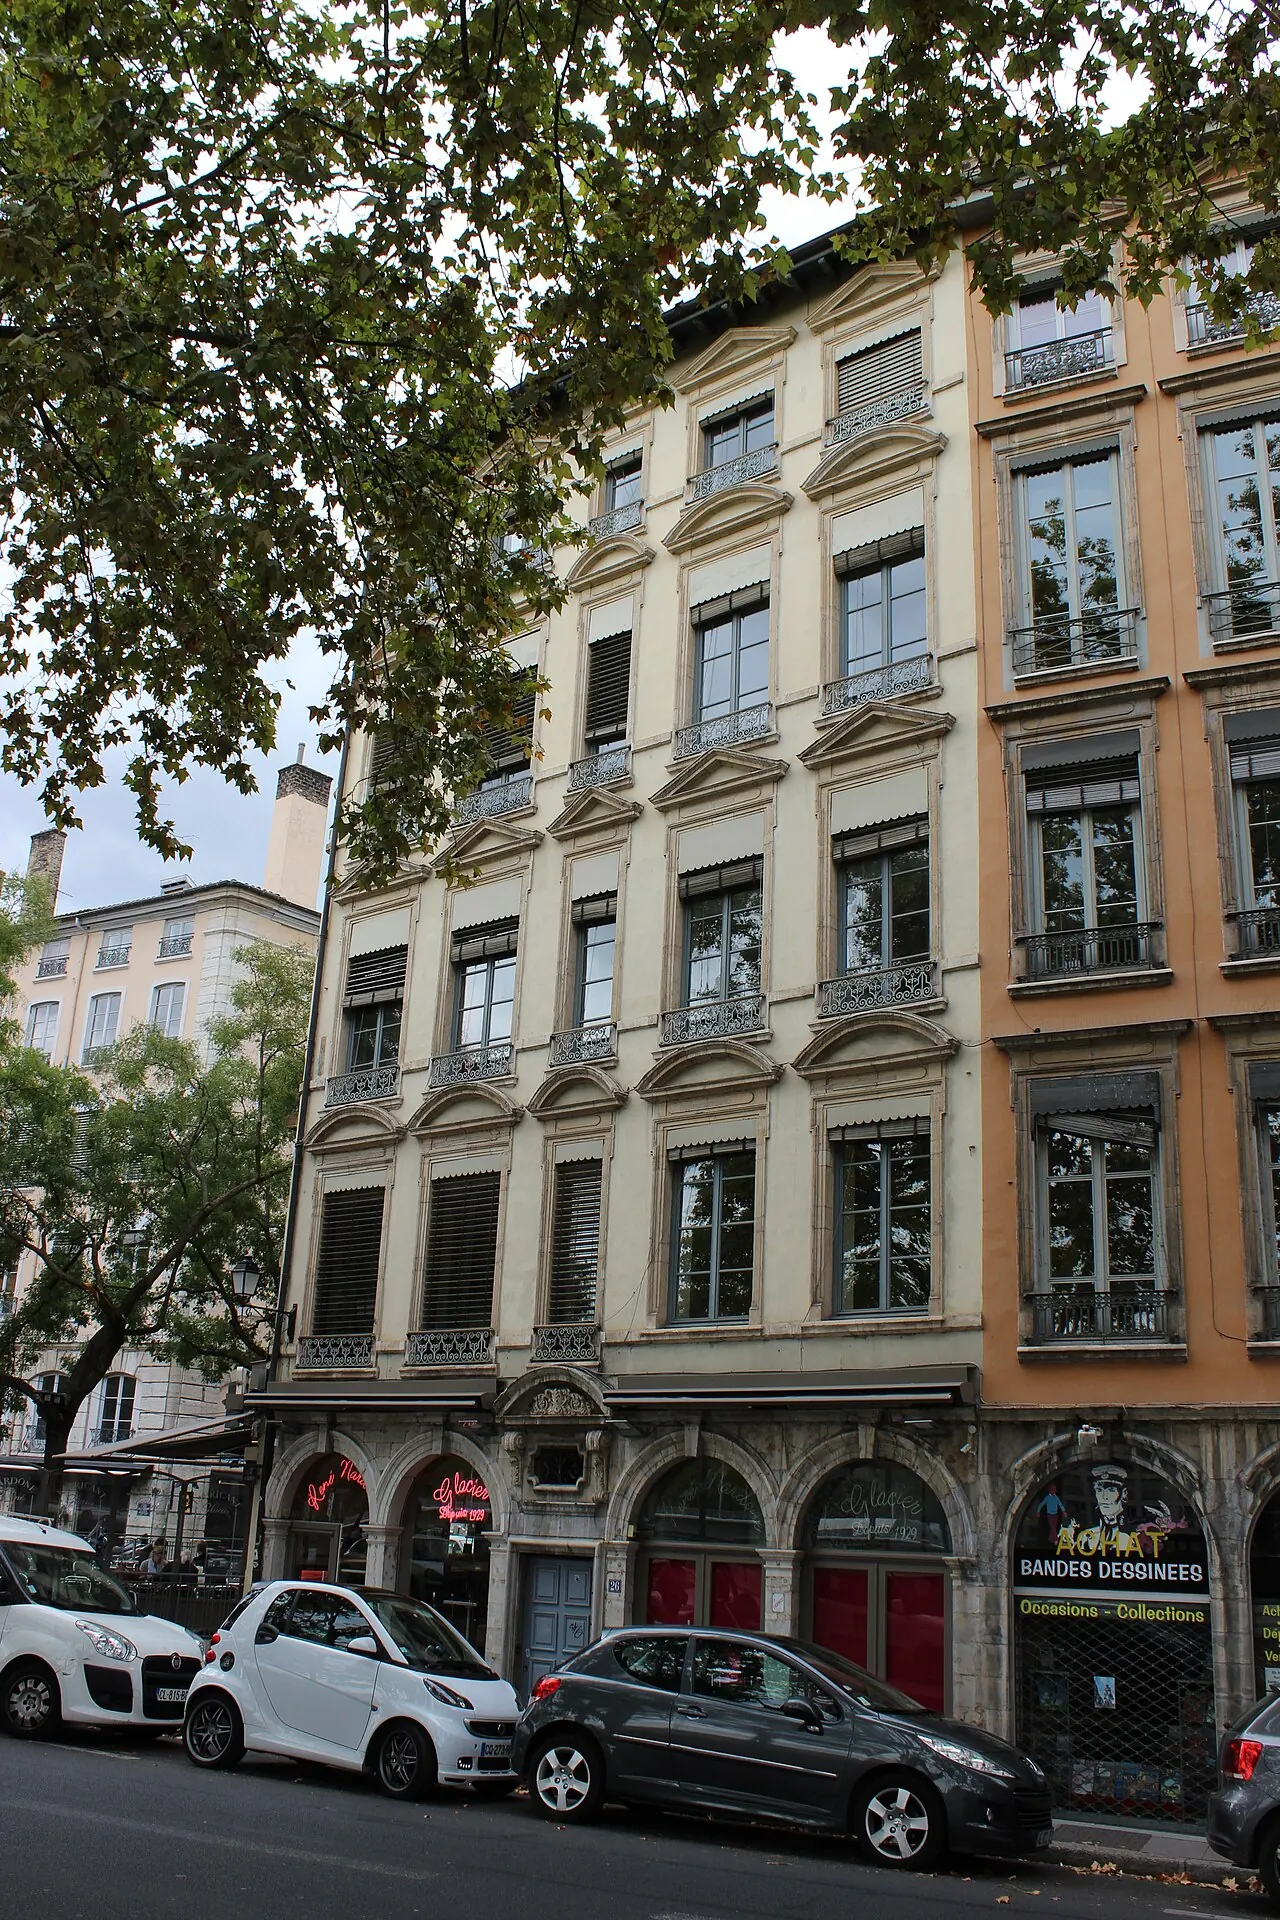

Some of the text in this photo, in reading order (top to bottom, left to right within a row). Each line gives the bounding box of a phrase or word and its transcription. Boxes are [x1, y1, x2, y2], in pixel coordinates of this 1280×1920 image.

[432, 1471, 490, 1504] Glacier
[840, 1480, 924, 1519] Glacier
[469, 1509, 486, 1521] 1929
[894, 1526, 919, 1541] 1929
[1055, 1529, 1165, 1559] ACHAT
[1020, 1559, 1205, 1582] BANDES DESSINEES
[610, 1580, 621, 1592] 26
[1019, 1599, 1099, 1618] Occasions
[1117, 1603, 1206, 1623] Collections
